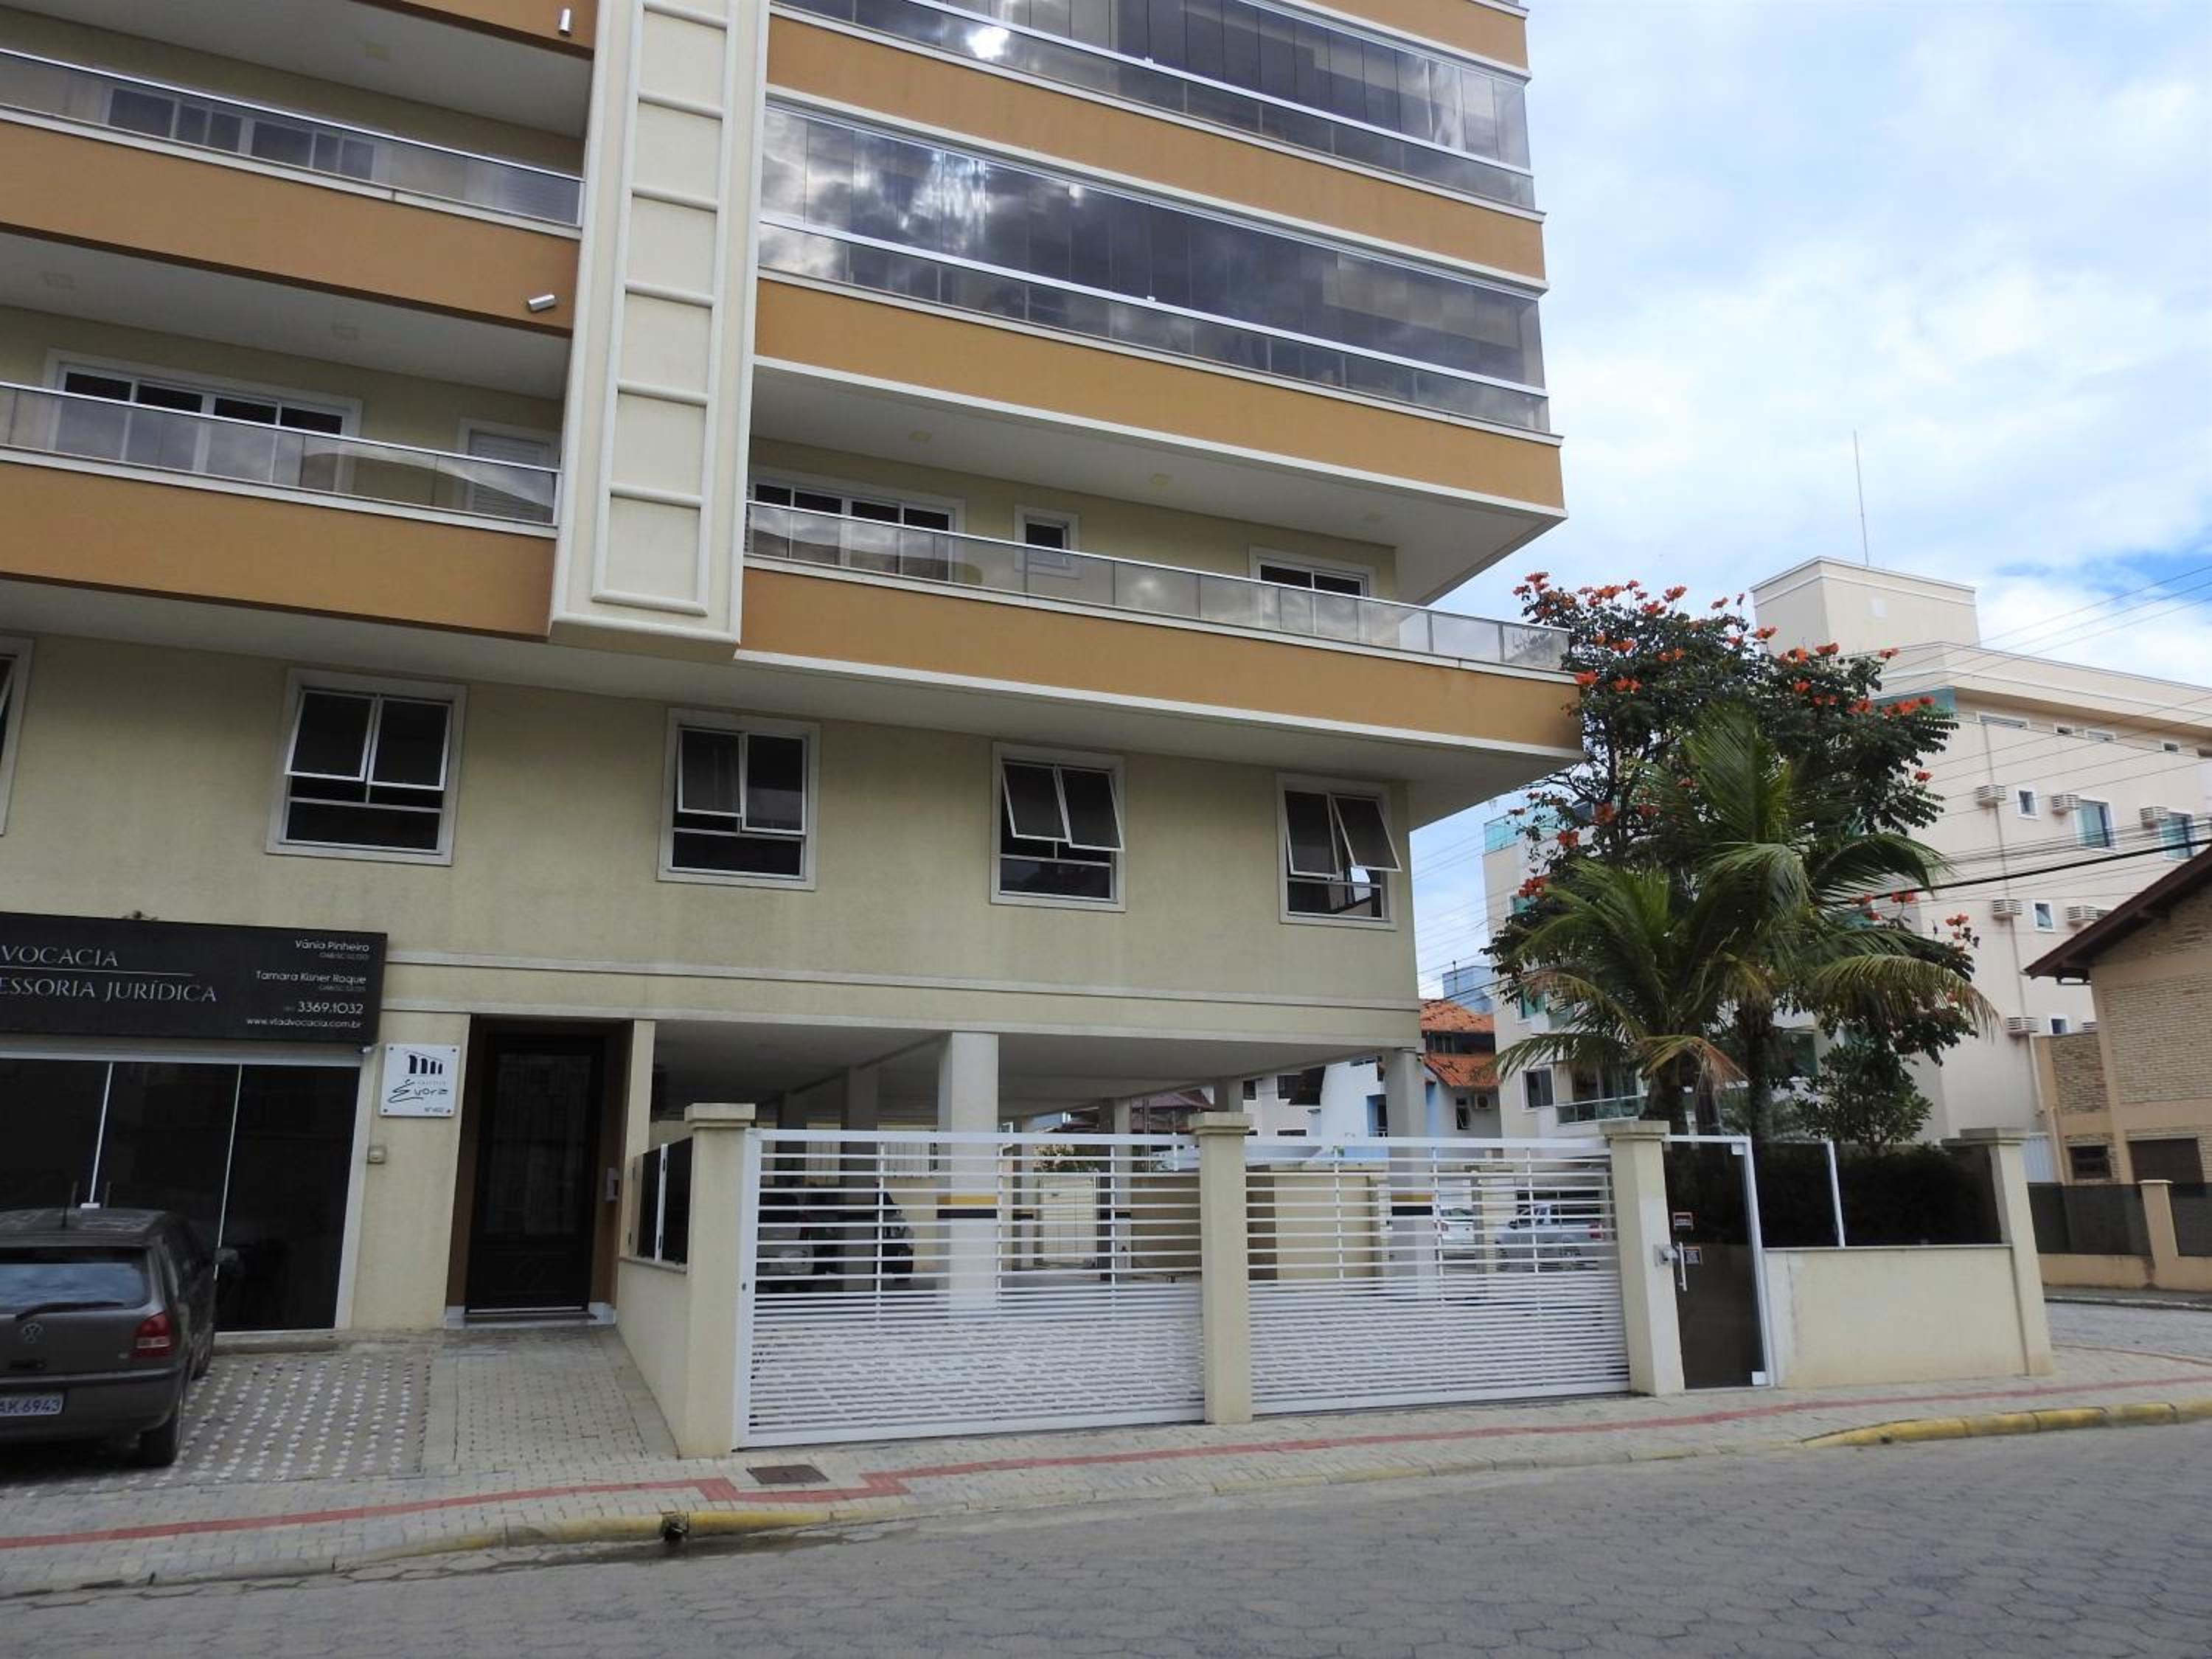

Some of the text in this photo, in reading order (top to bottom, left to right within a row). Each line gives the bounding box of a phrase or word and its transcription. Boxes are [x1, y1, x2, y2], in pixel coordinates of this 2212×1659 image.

[295, 939, 369, 952] Vânia Pinheiro
[1, 945, 118, 967] VOCACIA
[256, 970, 298, 981] Tamara
[333, 974, 366, 986] Roque
[105, 979, 216, 1002] JURÍDICA
